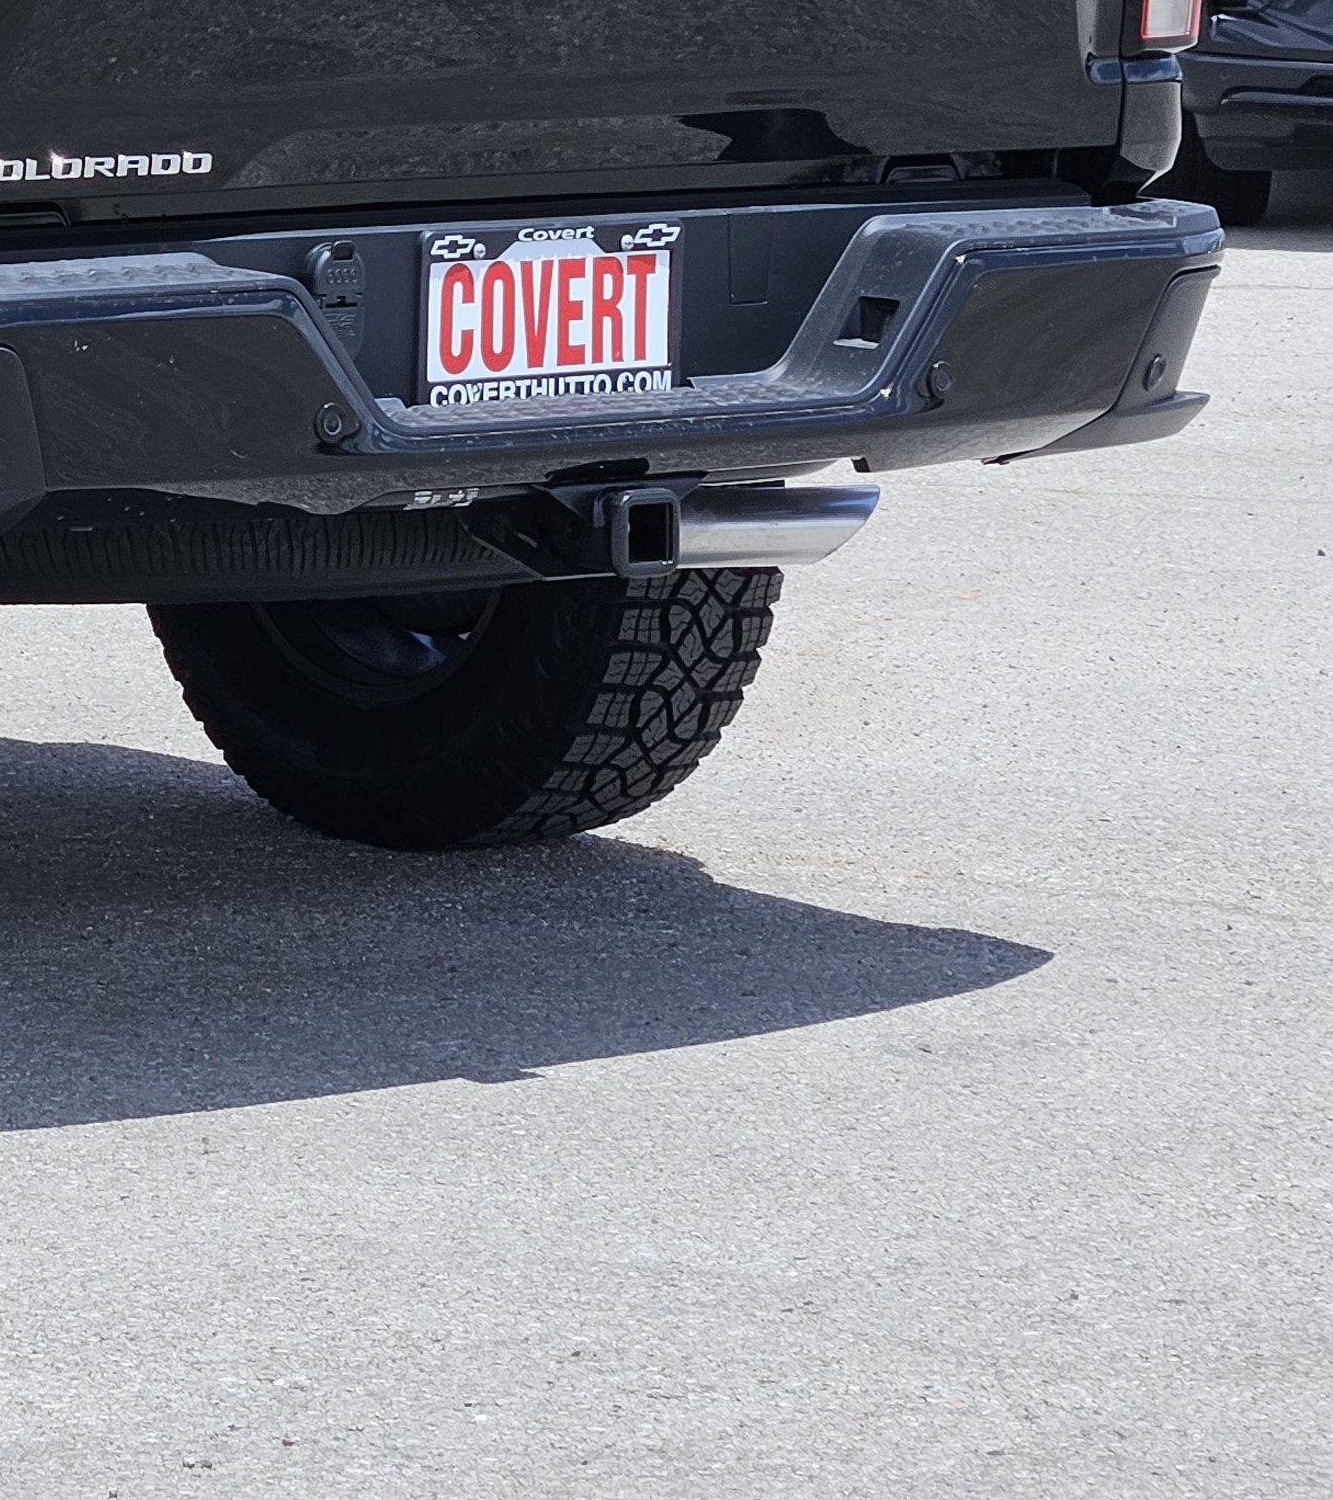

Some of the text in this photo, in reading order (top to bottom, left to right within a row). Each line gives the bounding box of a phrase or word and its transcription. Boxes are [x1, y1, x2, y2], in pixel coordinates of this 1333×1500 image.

[517, 226, 595, 241] Covert
[439, 253, 657, 375] COVERT
[430, 370, 672, 407] COVERTHUTTO.COM
